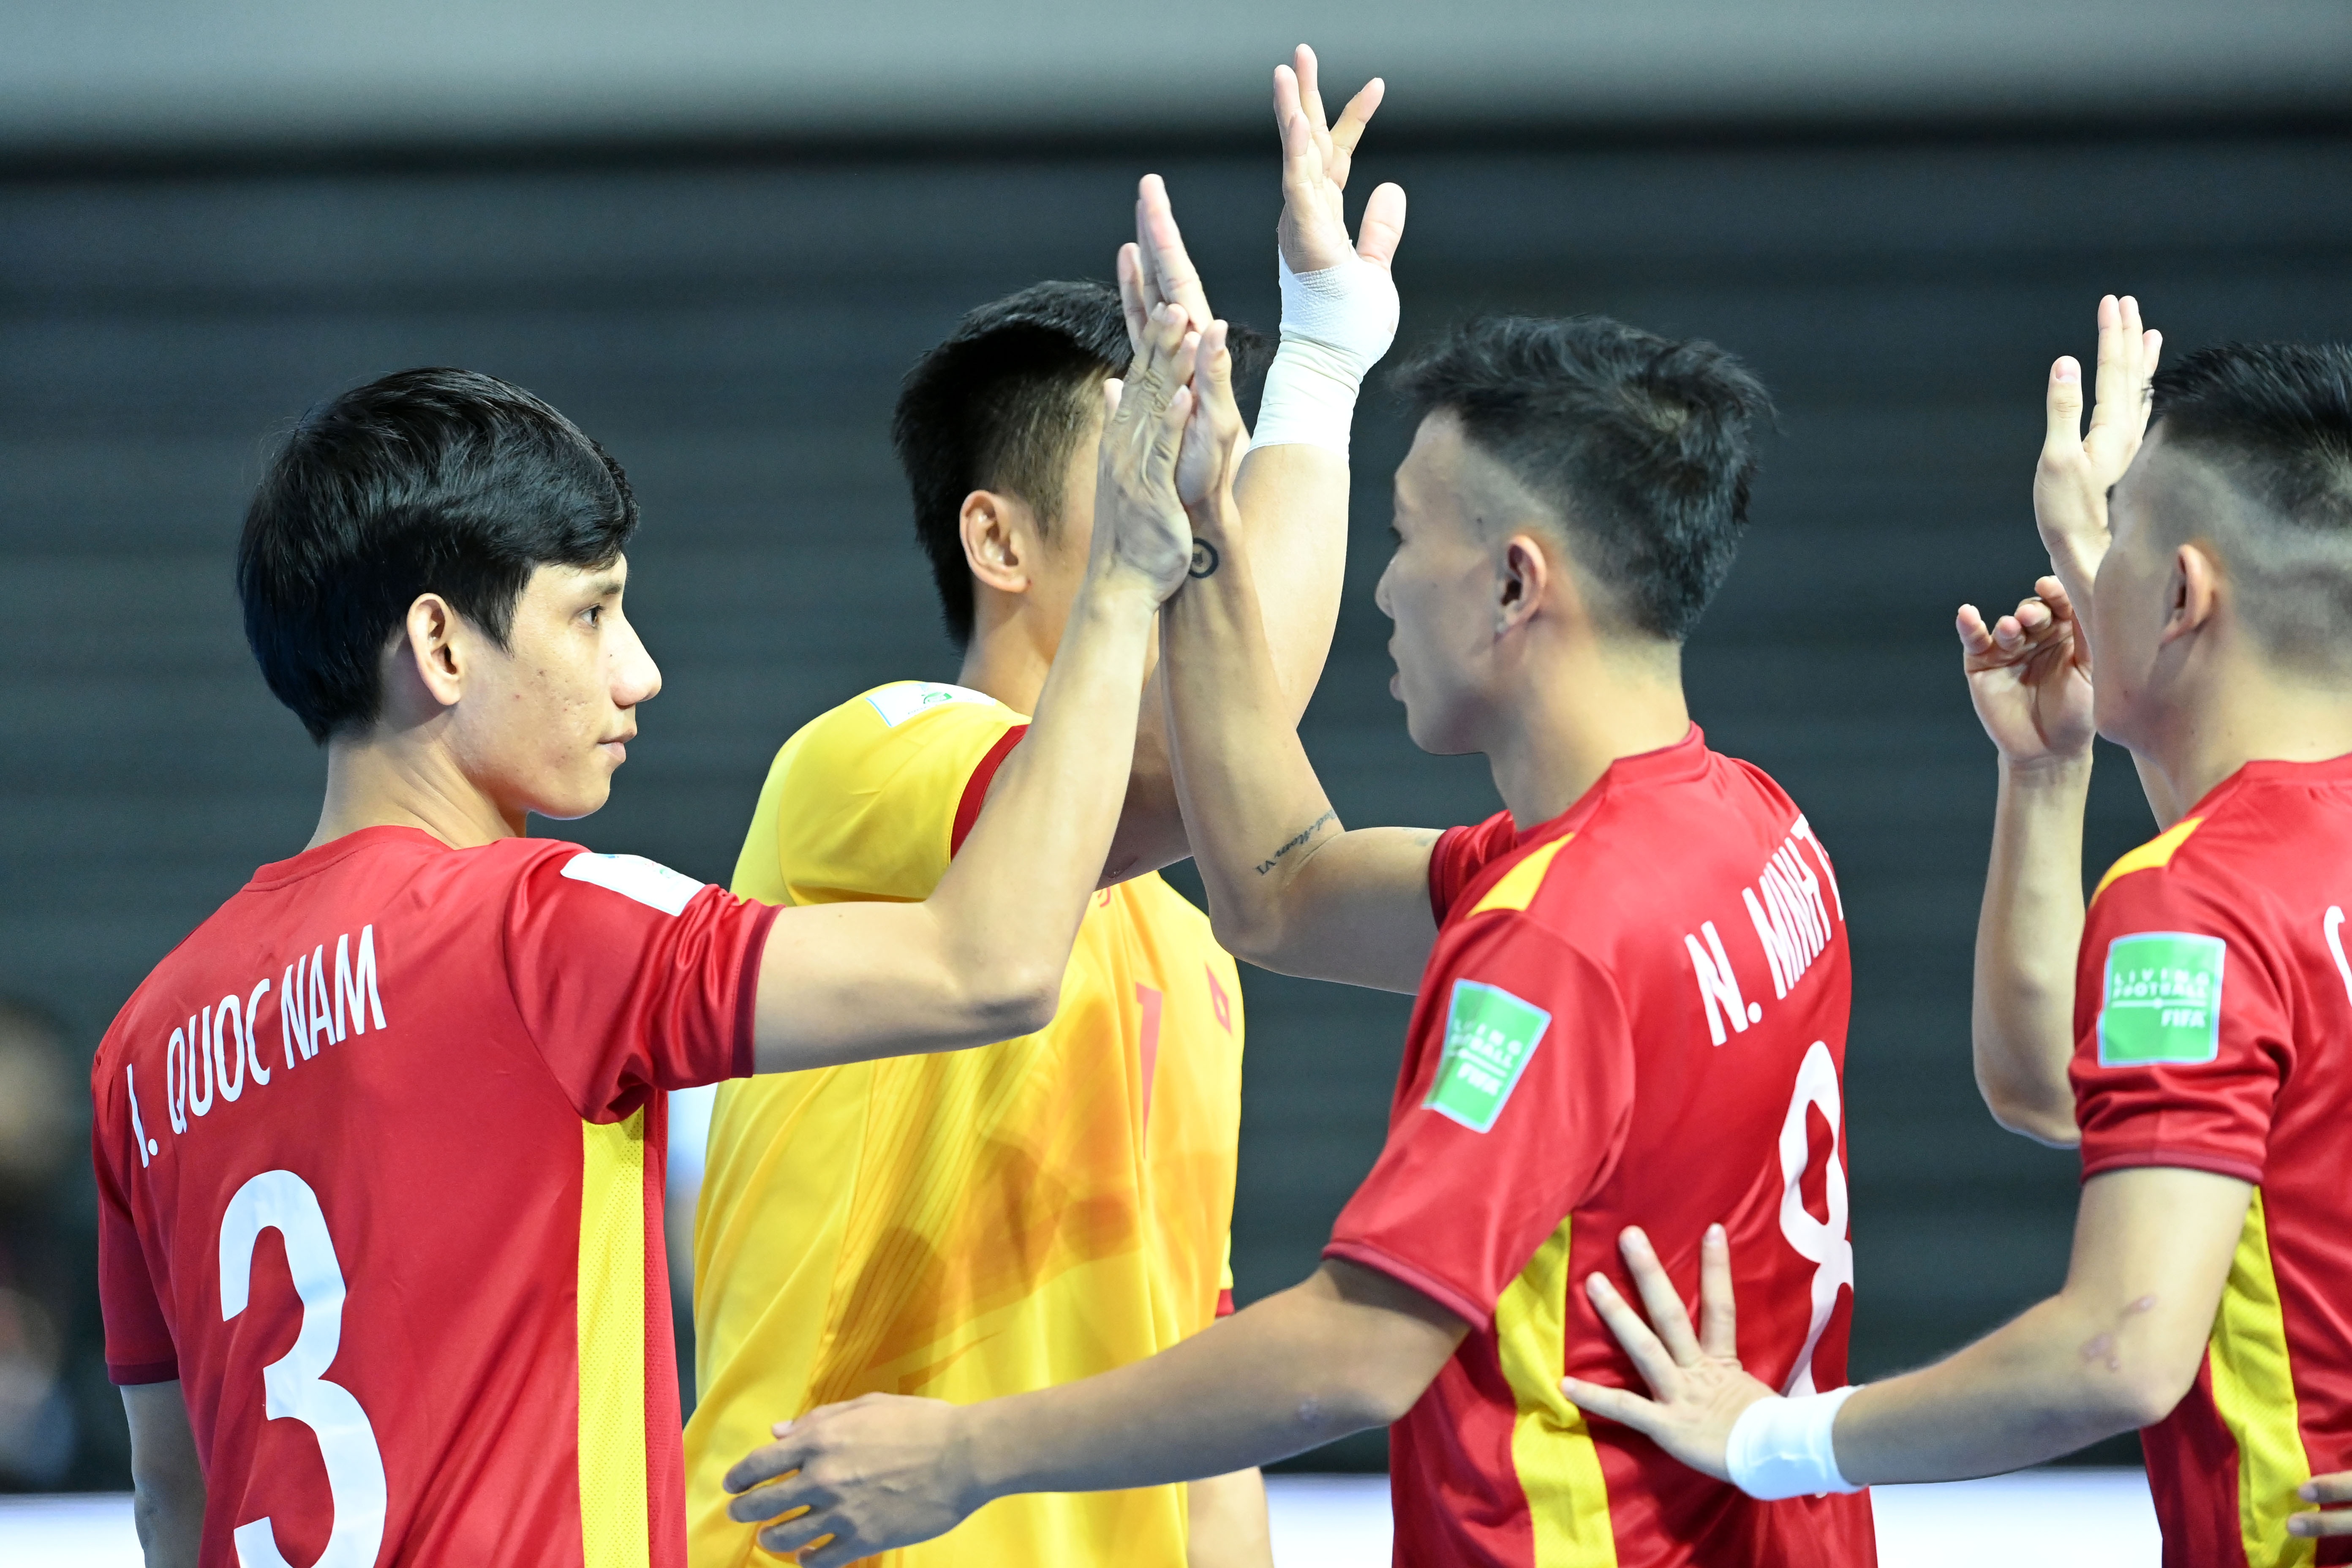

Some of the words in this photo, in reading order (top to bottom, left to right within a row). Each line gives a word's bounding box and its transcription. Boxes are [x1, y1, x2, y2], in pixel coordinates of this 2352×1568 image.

[125, 1063, 158, 1168] I.
[167, 978, 271, 1135] QUOC
[280, 924, 387, 1070] NAM
[1684, 920, 1762, 1046] N.
[2161, 1008, 2206, 1028] FIFA
[219, 1170, 387, 1568] 3
